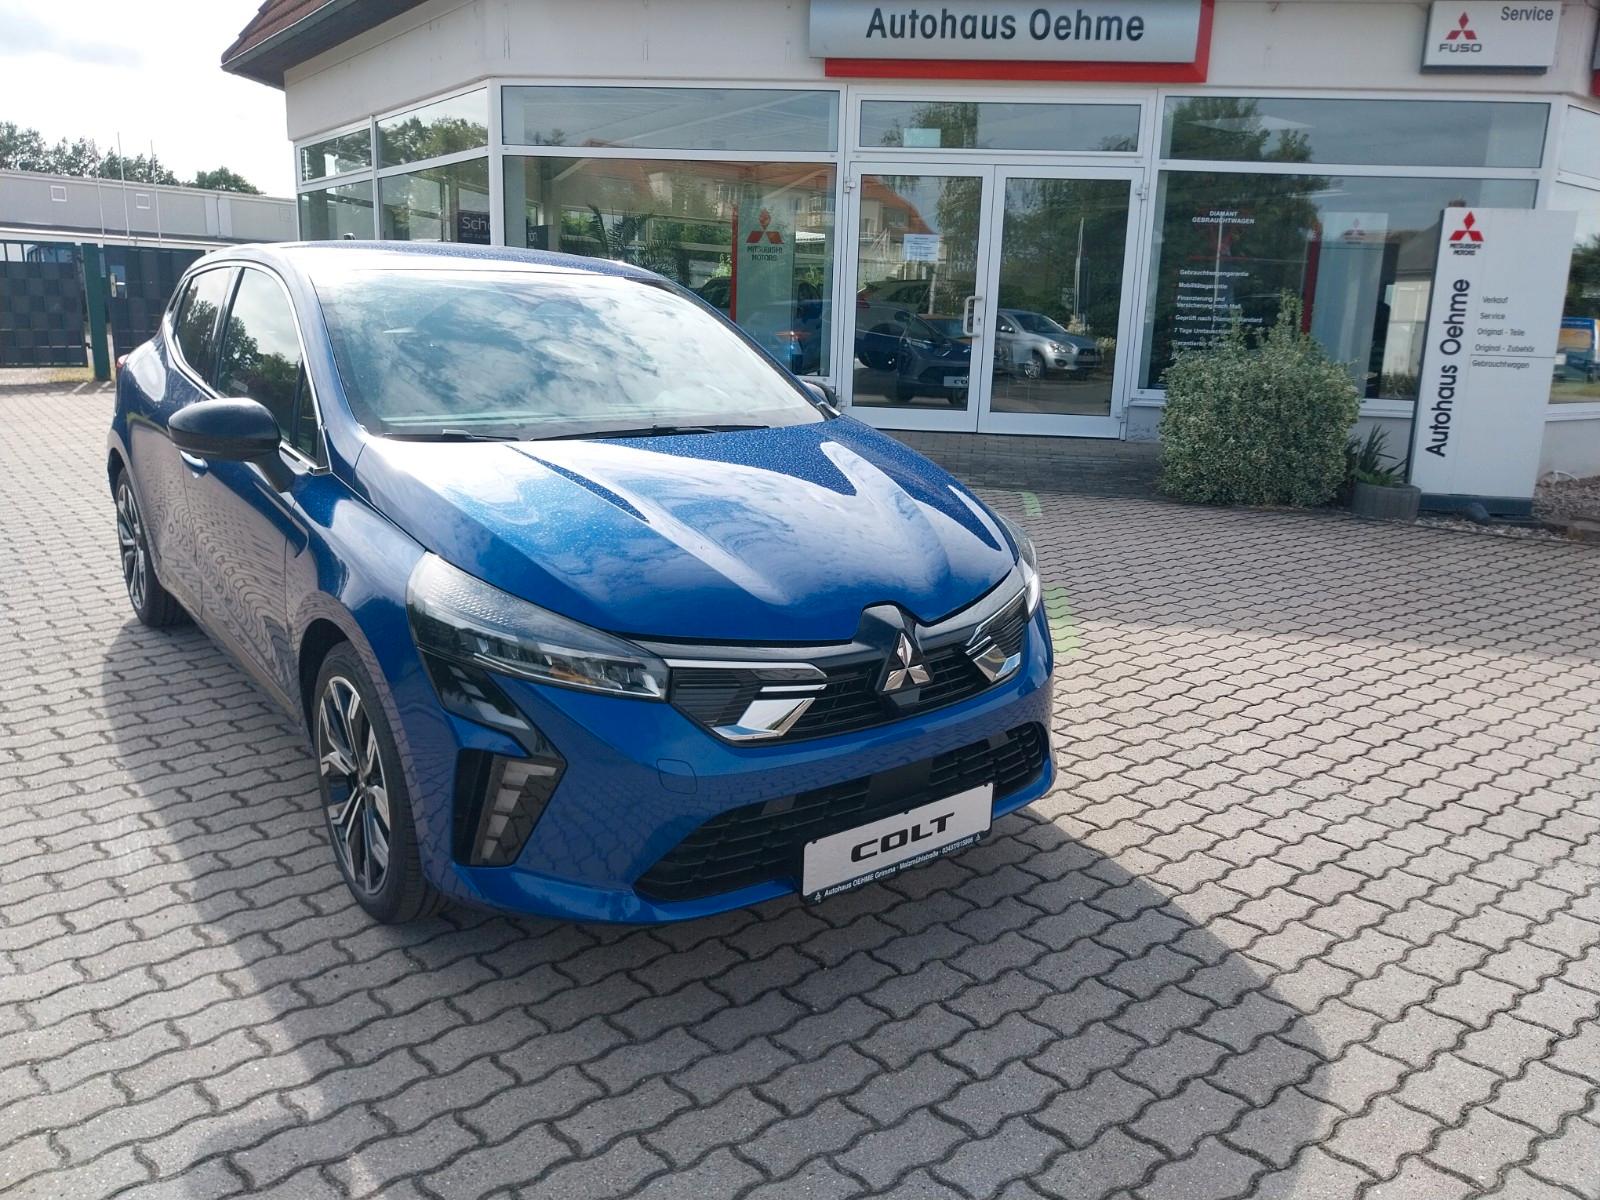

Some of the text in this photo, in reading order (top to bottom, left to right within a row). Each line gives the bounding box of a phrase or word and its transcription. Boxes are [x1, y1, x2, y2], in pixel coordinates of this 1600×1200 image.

[1500, 6, 1554, 22] Service
[866, 7, 1145, 41] Autohaus Oehme
[1438, 43, 1483, 53] FUSO
[462, 216, 490, 231] Sch
[1191, 216, 1255, 225] GEBRAUCHTWAGEN
[746, 245, 783, 254] MITSUBISHI
[751, 254, 777, 262] MOTORS
[1482, 296, 1509, 304] Verkauf
[1175, 314, 1197, 322] Geprüft
[1480, 312, 1506, 320] Service
[1476, 327, 1504, 336] Original
[1510, 328, 1525, 336] Teile
[1474, 343, 1501, 352] Original
[1425, 279, 1470, 458] Autohaus Oehme
[1471, 359, 1530, 370] Gebrauchtwagen
[850, 811, 955, 863] COLT
[824, 883, 852, 897] Autohaus
[852, 873, 874, 887] OEHME
[874, 866, 896, 879] Grimma
